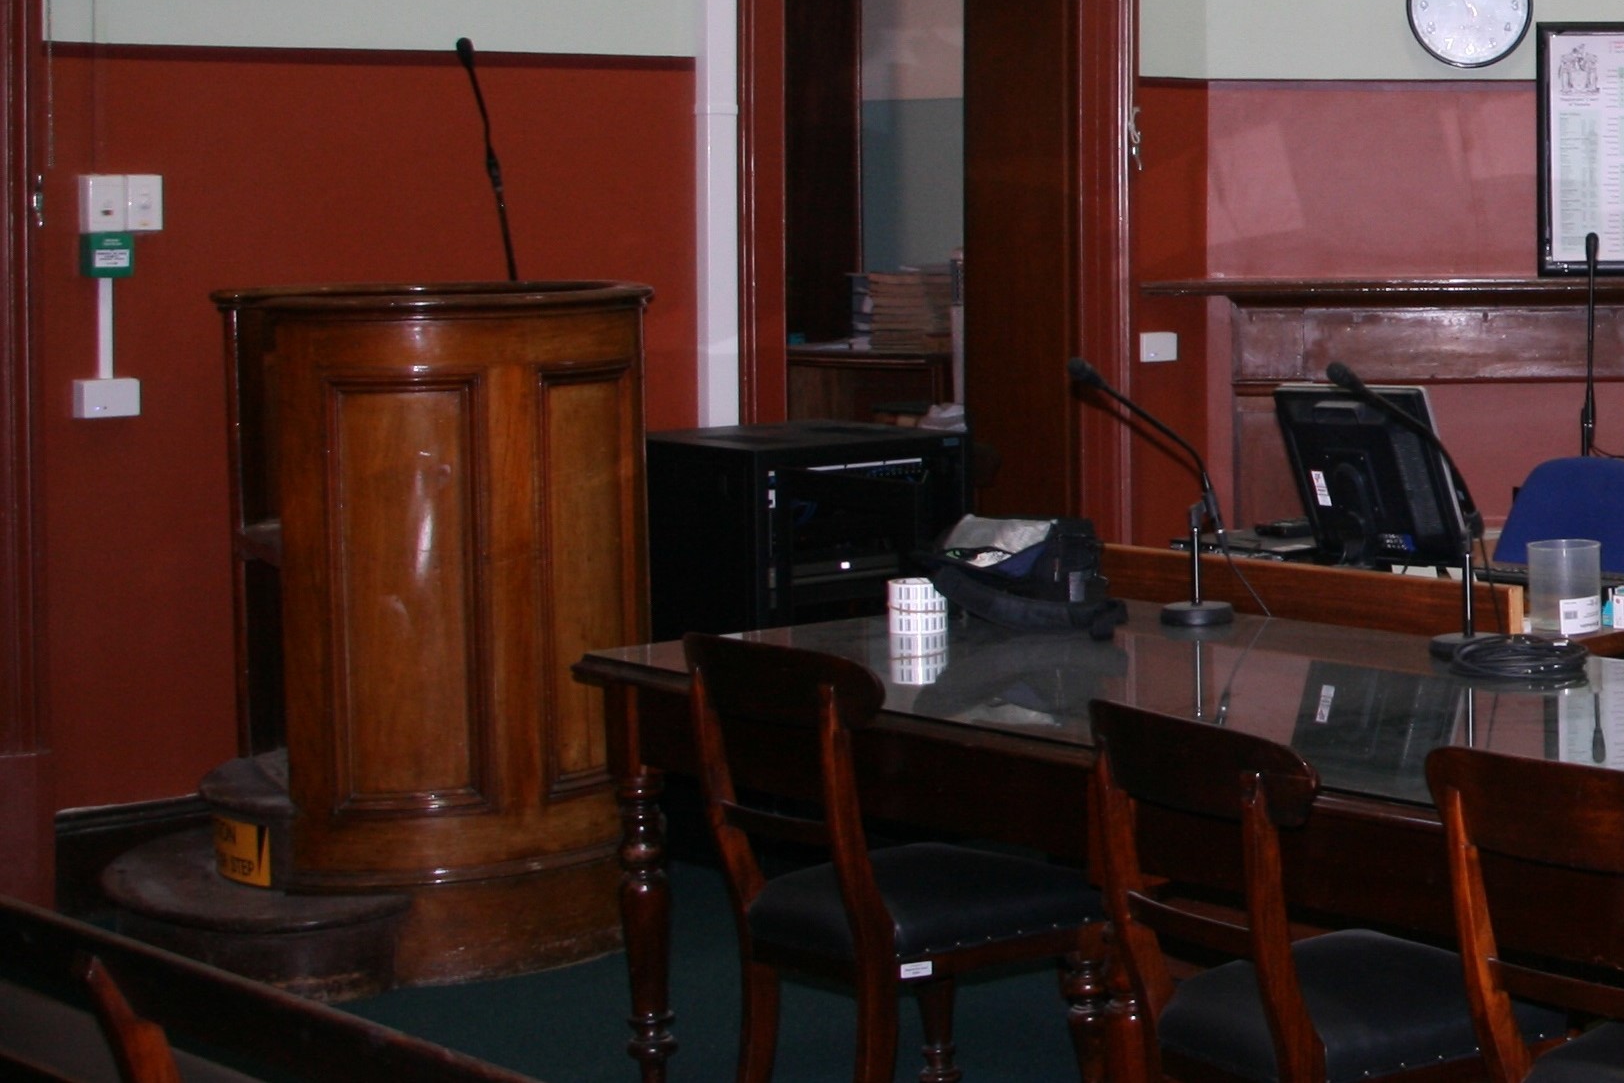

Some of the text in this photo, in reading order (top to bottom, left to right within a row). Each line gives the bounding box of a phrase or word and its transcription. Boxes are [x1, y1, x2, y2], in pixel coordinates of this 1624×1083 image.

[1420, 0, 1429, 11] 9
[1511, 0, 1519, 11] 3
[1504, 22, 1512, 32] 4
[1445, 38, 1454, 50] 7
[231, 855, 255, 876] STEP
